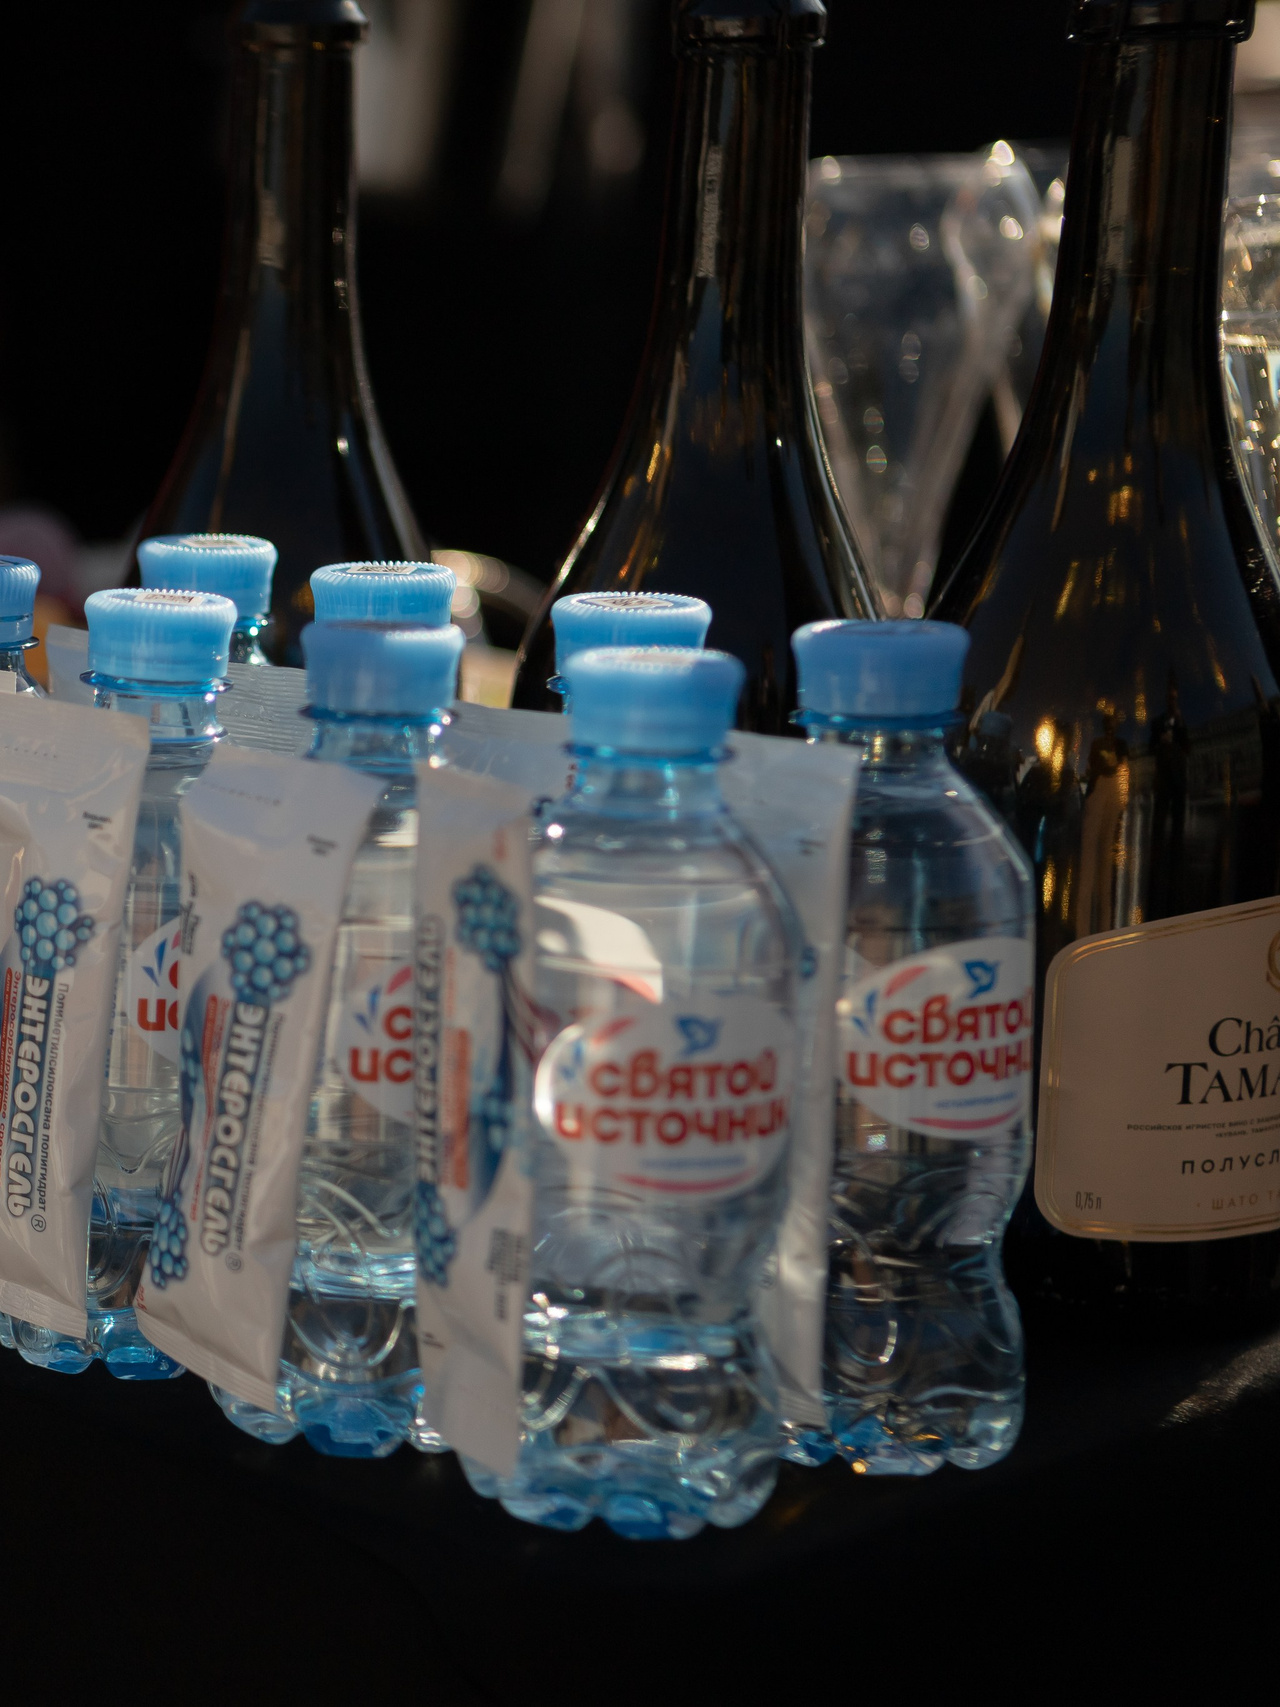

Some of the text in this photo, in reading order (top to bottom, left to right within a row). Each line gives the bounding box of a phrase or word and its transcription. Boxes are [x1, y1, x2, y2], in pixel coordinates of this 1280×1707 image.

[1, 970, 21, 1119] Энтеросорбирующее
[7, 974, 50, 1217] ЭНТЕРОСГЕЛЬ
[42, 982, 69, 1130] Полиметилсилоксана
[37, 1133, 50, 1212] полигидрат
[201, 1001, 265, 1254] ЭНТЕРОСГЕЛЬ
[1075, 1190, 1094, 1212] 0,75
[1211, 1193, 1259, 1211] ШАТО
